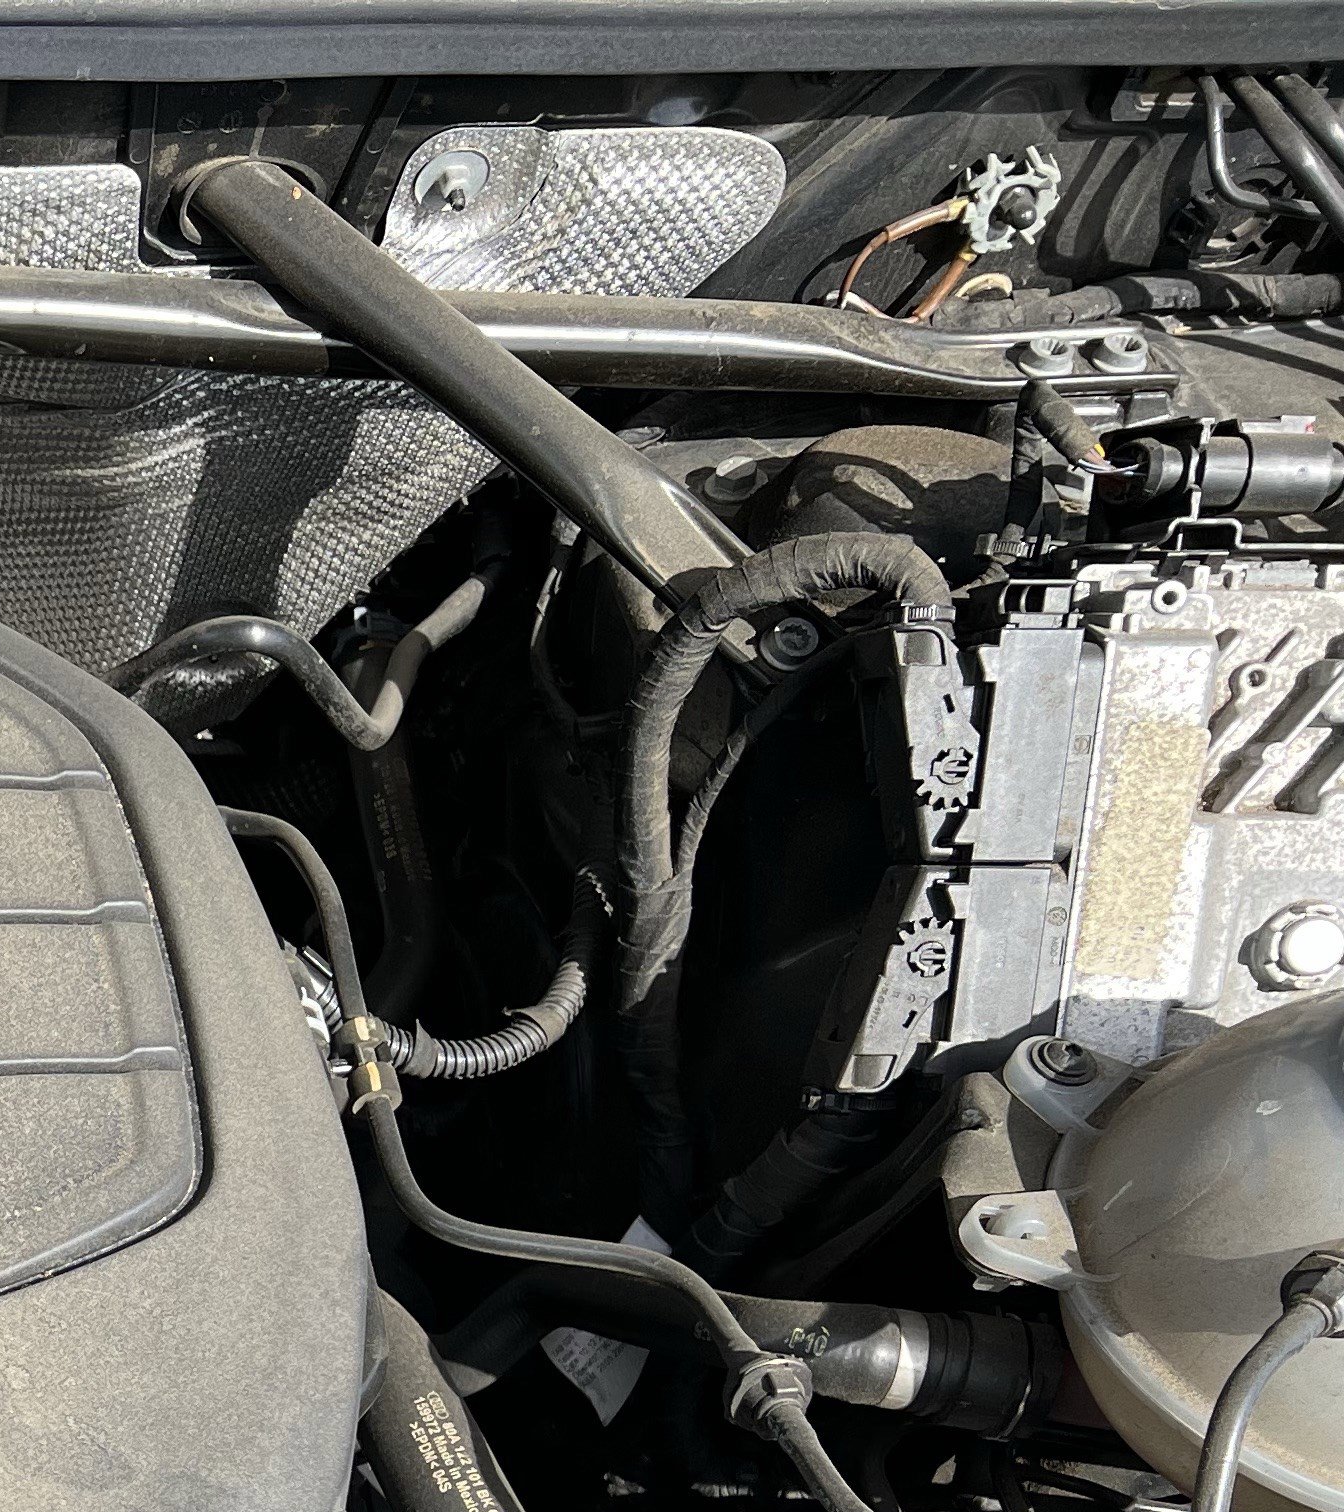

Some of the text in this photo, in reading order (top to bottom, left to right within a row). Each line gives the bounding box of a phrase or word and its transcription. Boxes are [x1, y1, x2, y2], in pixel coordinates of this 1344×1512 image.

[412, 1395, 442, 1435] 159972
[432, 1434, 456, 1467] Made
[447, 1464, 462, 1480] in
[465, 1466, 484, 1487] 101
[475, 1487, 495, 1508] BK
